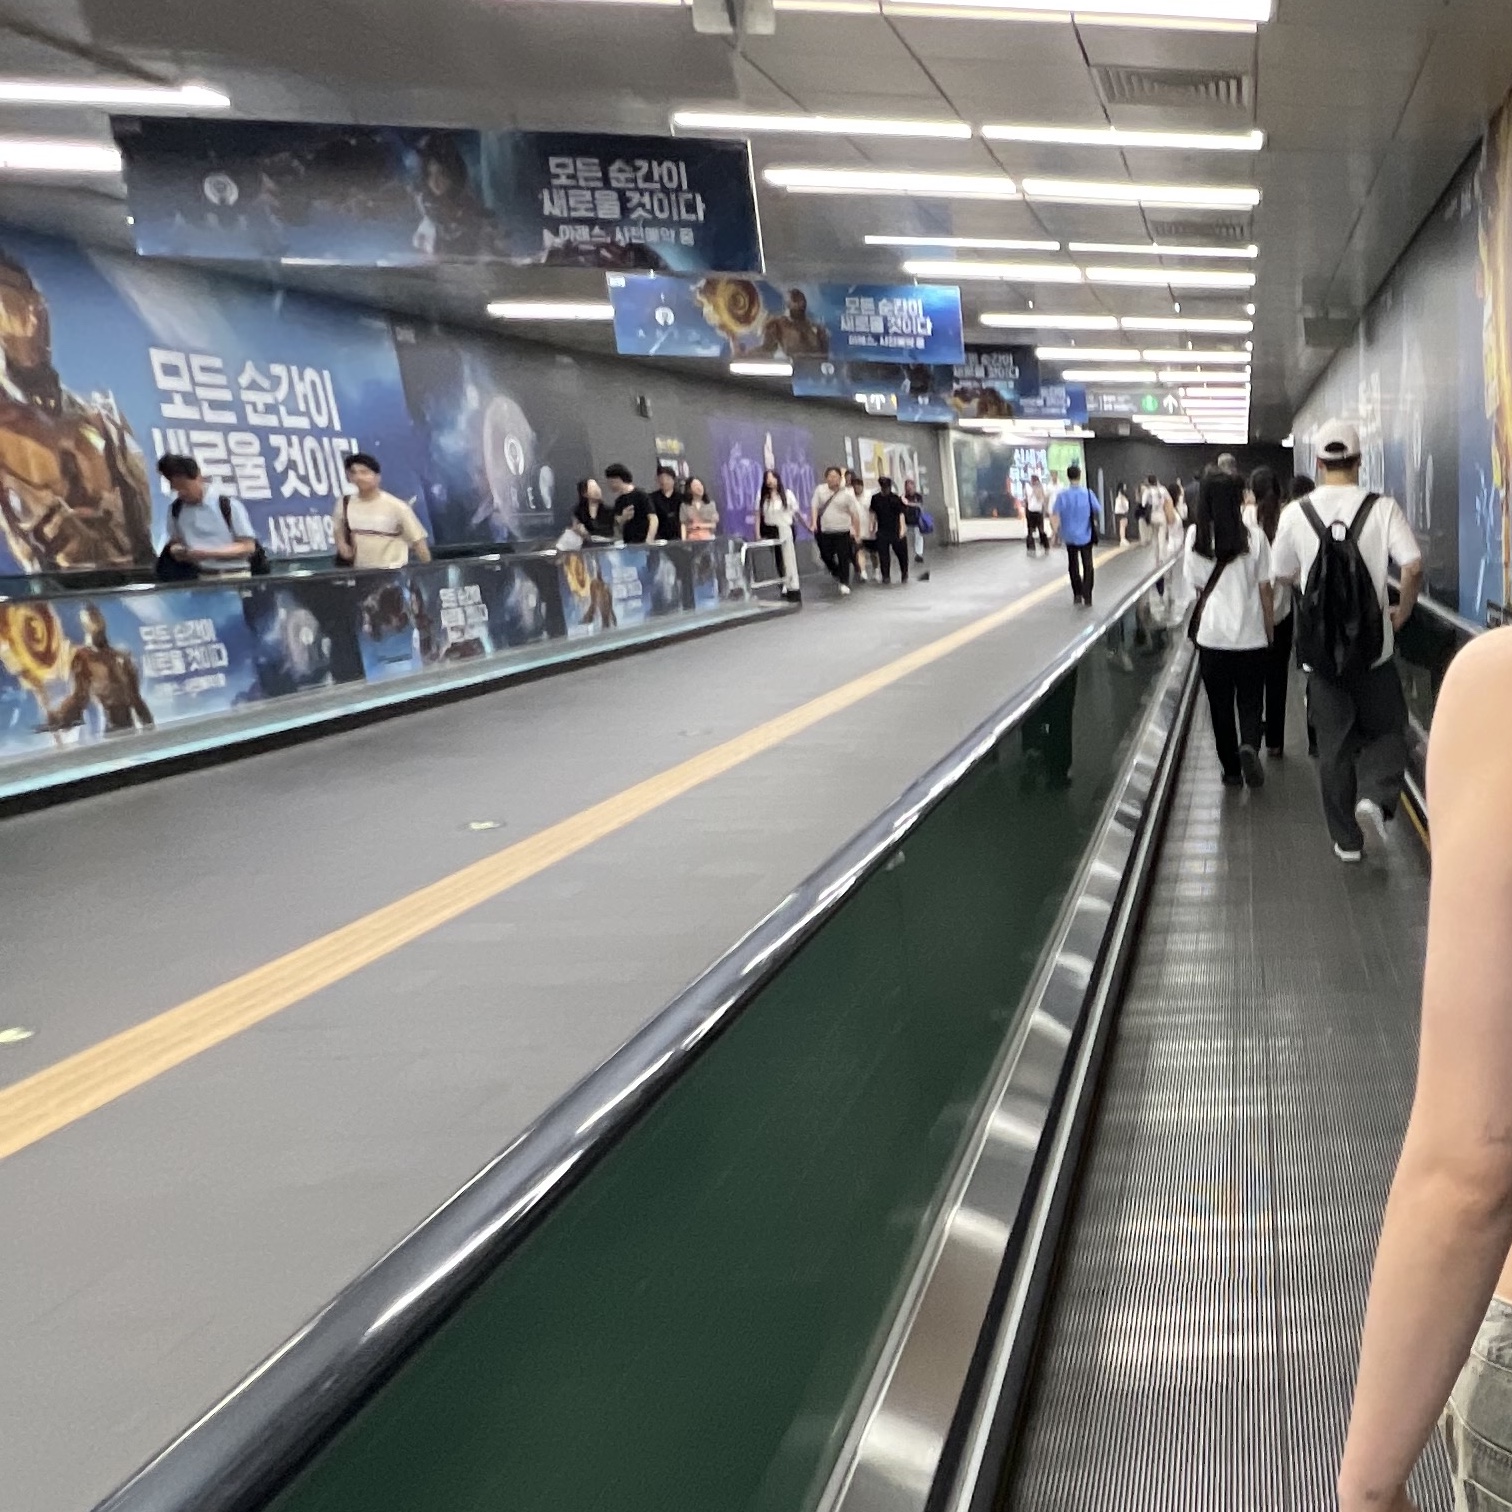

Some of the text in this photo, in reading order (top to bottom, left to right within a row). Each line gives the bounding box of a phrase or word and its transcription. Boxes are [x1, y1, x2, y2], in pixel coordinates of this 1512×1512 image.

[548, 156, 689, 191] 모든 순간이
[541, 187, 707, 223] 새로울 것이다
[149, 346, 342, 432] 모든 순간이
